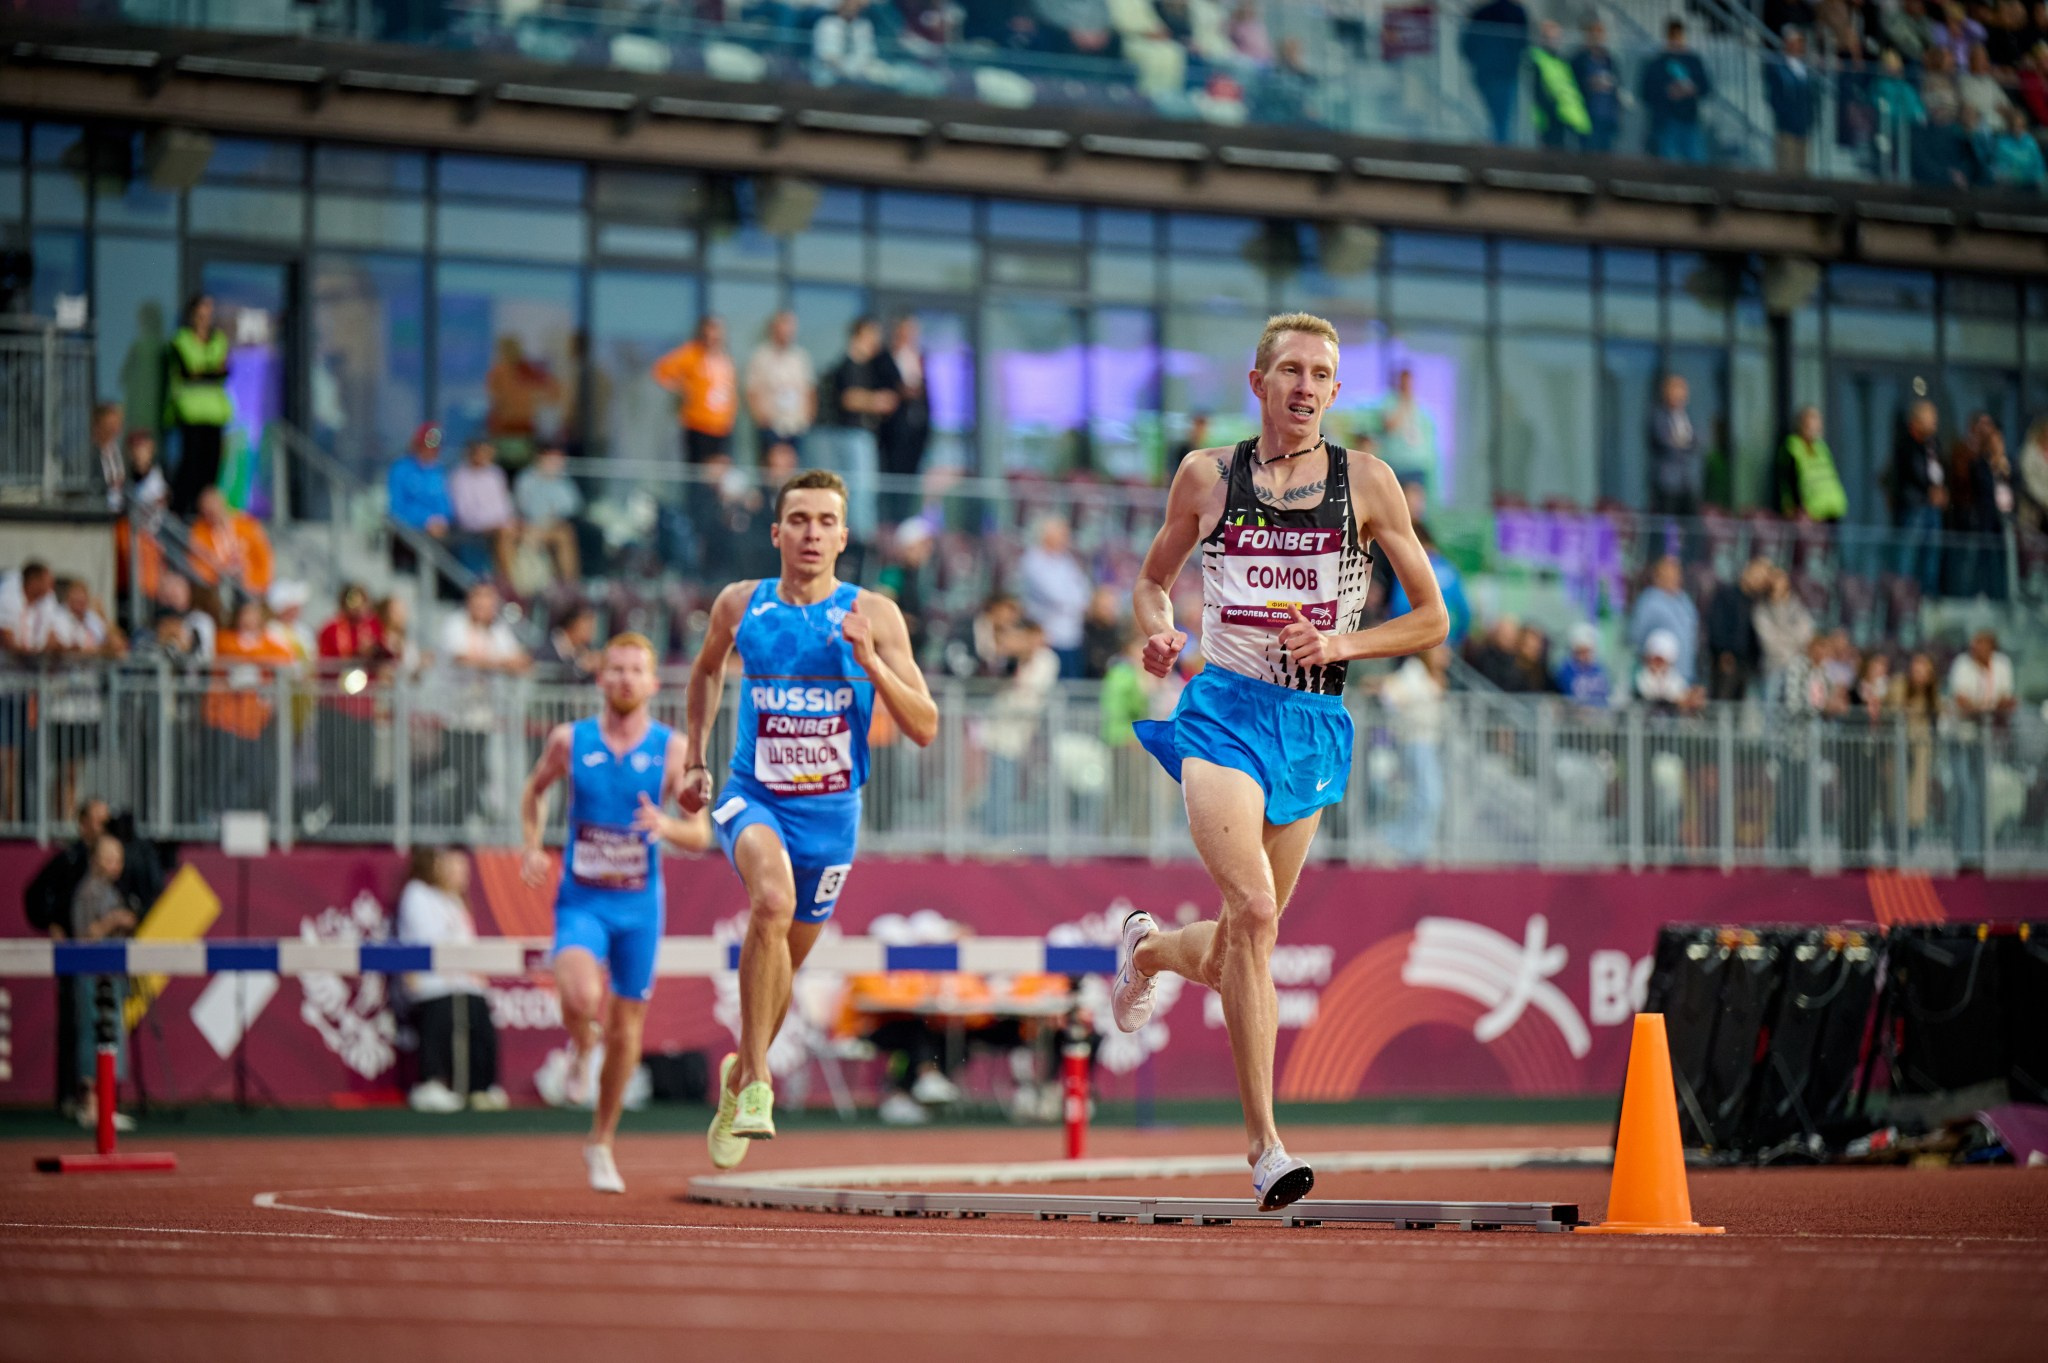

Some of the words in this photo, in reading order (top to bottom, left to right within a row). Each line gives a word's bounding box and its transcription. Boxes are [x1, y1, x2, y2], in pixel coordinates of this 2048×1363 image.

[1237, 529, 1331, 552] FONBET
[1246, 565, 1318, 591] СОМОВ
[1226, 609, 1270, 619] КОРОЛЕВА
[751, 686, 853, 713] RUSSIA
[765, 715, 841, 736] FONBET
[769, 746, 838, 767] ШВЕЦОВ
[825, 871, 841, 895] 3
